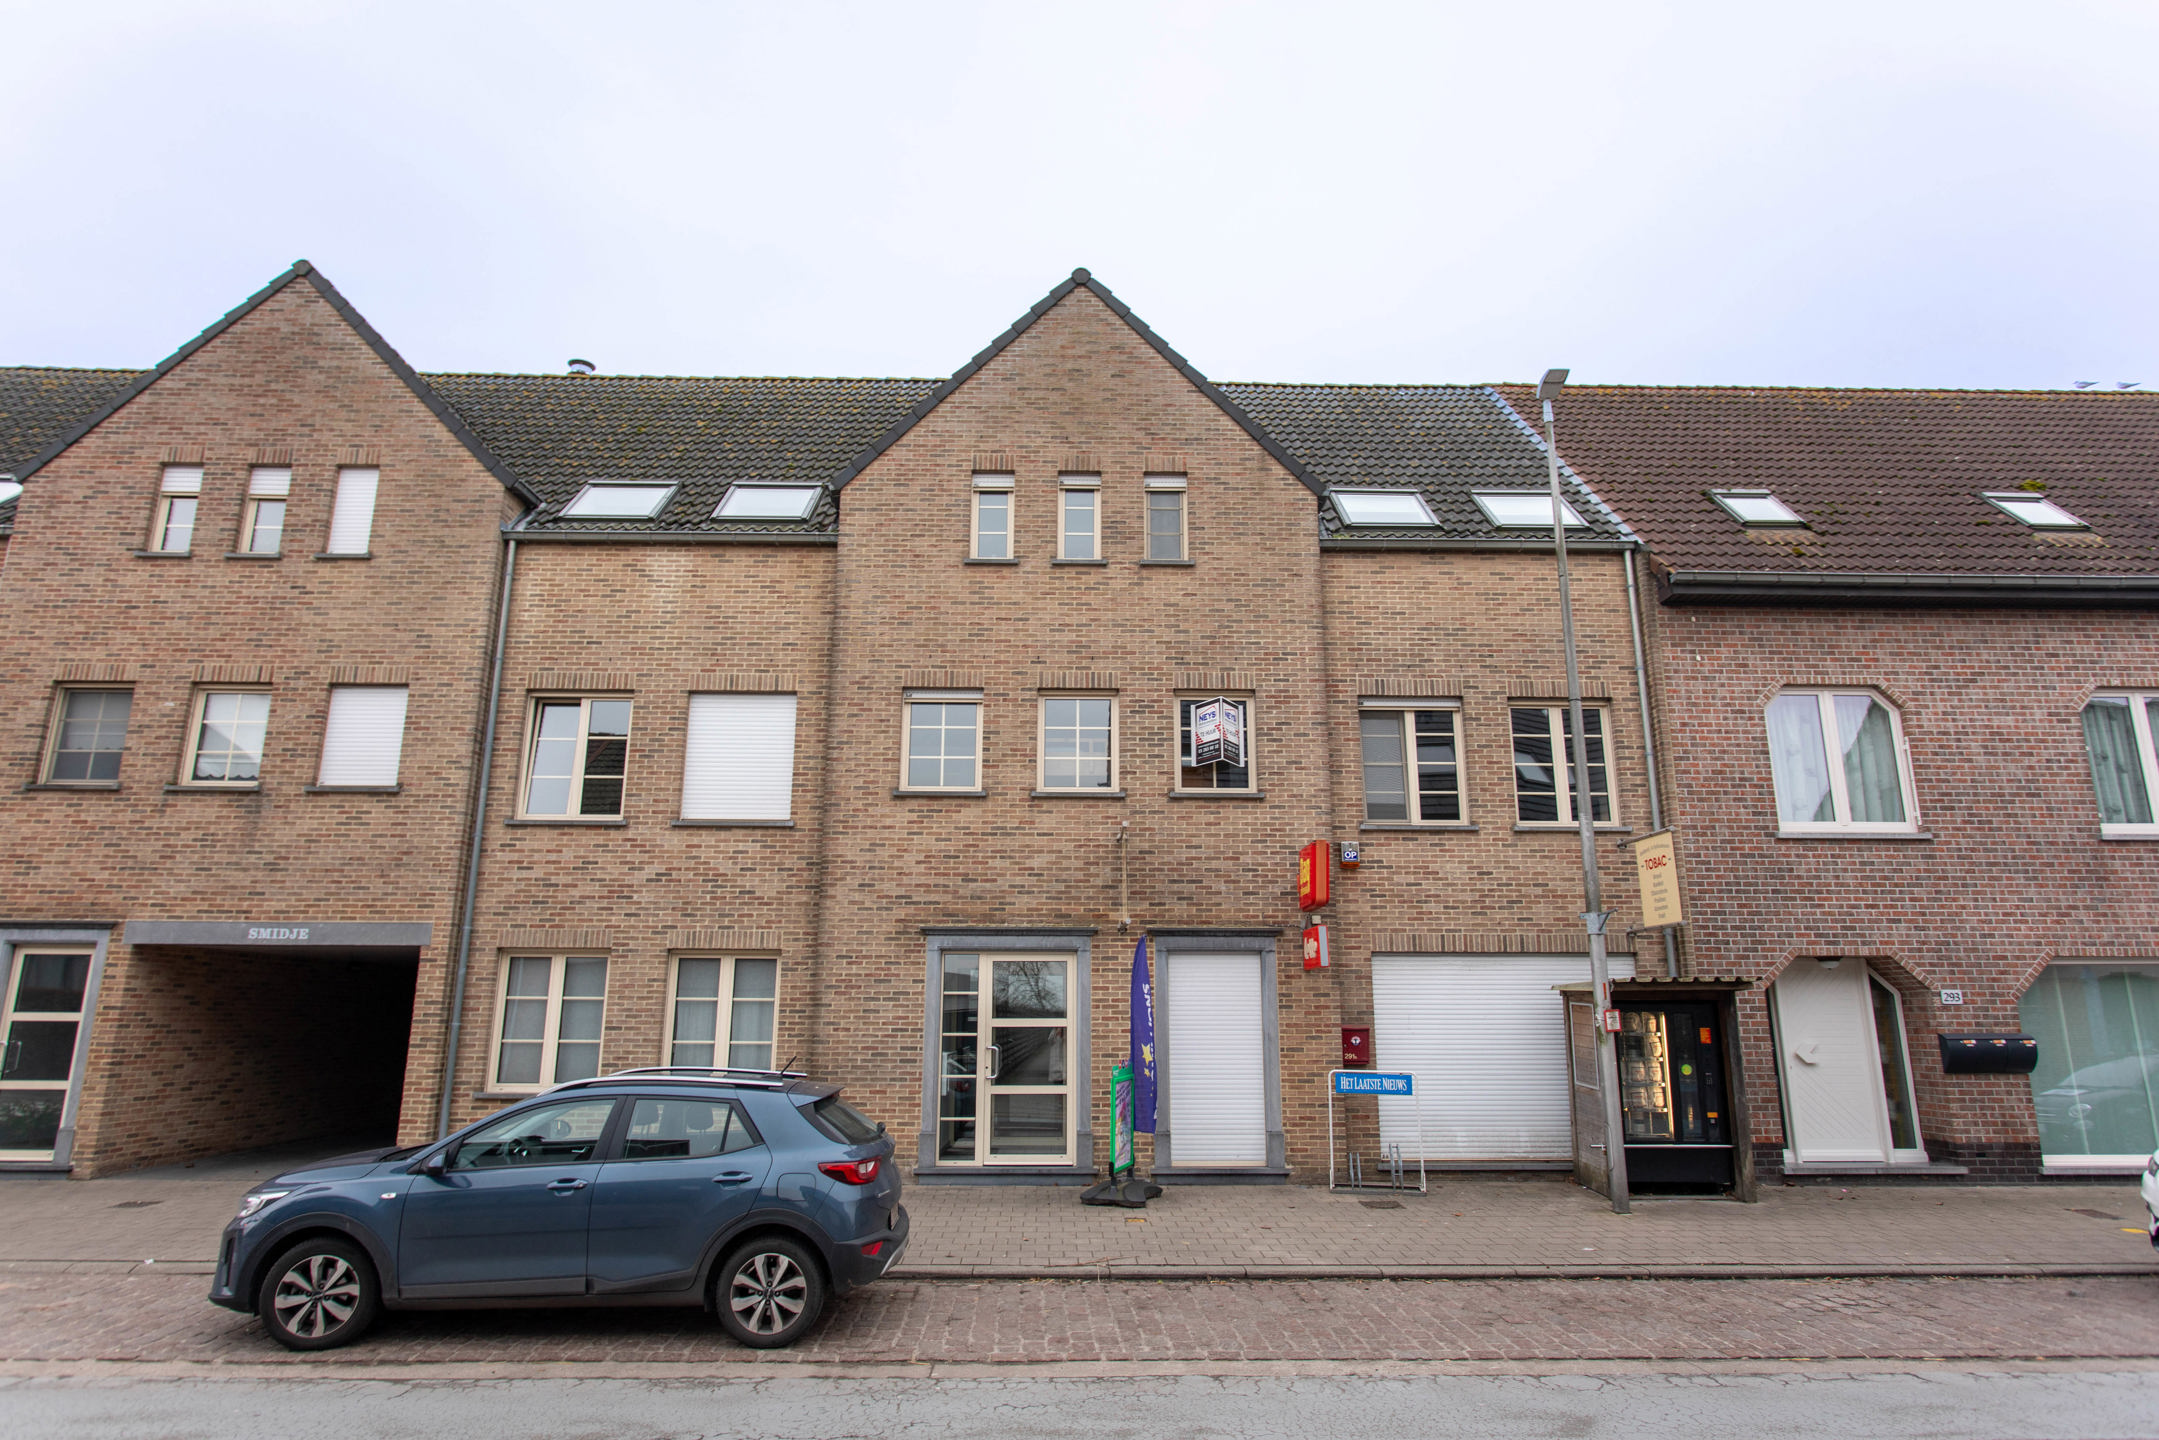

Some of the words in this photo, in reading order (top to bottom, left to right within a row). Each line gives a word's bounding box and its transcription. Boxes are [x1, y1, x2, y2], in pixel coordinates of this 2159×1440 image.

[1199, 711, 1216, 722] NEYS
[1225, 711, 1236, 722] NEYS
[1344, 851, 1357, 859] OP
[1644, 855, 1668, 871] TOBAC
[248, 927, 310, 940] SMIDJE
[1943, 992, 1961, 1002] 293
[1340, 1076, 1354, 1090] HET
[1354, 1077, 1382, 1091] LAATSTE
[1382, 1077, 1408, 1091] NIEUWS
